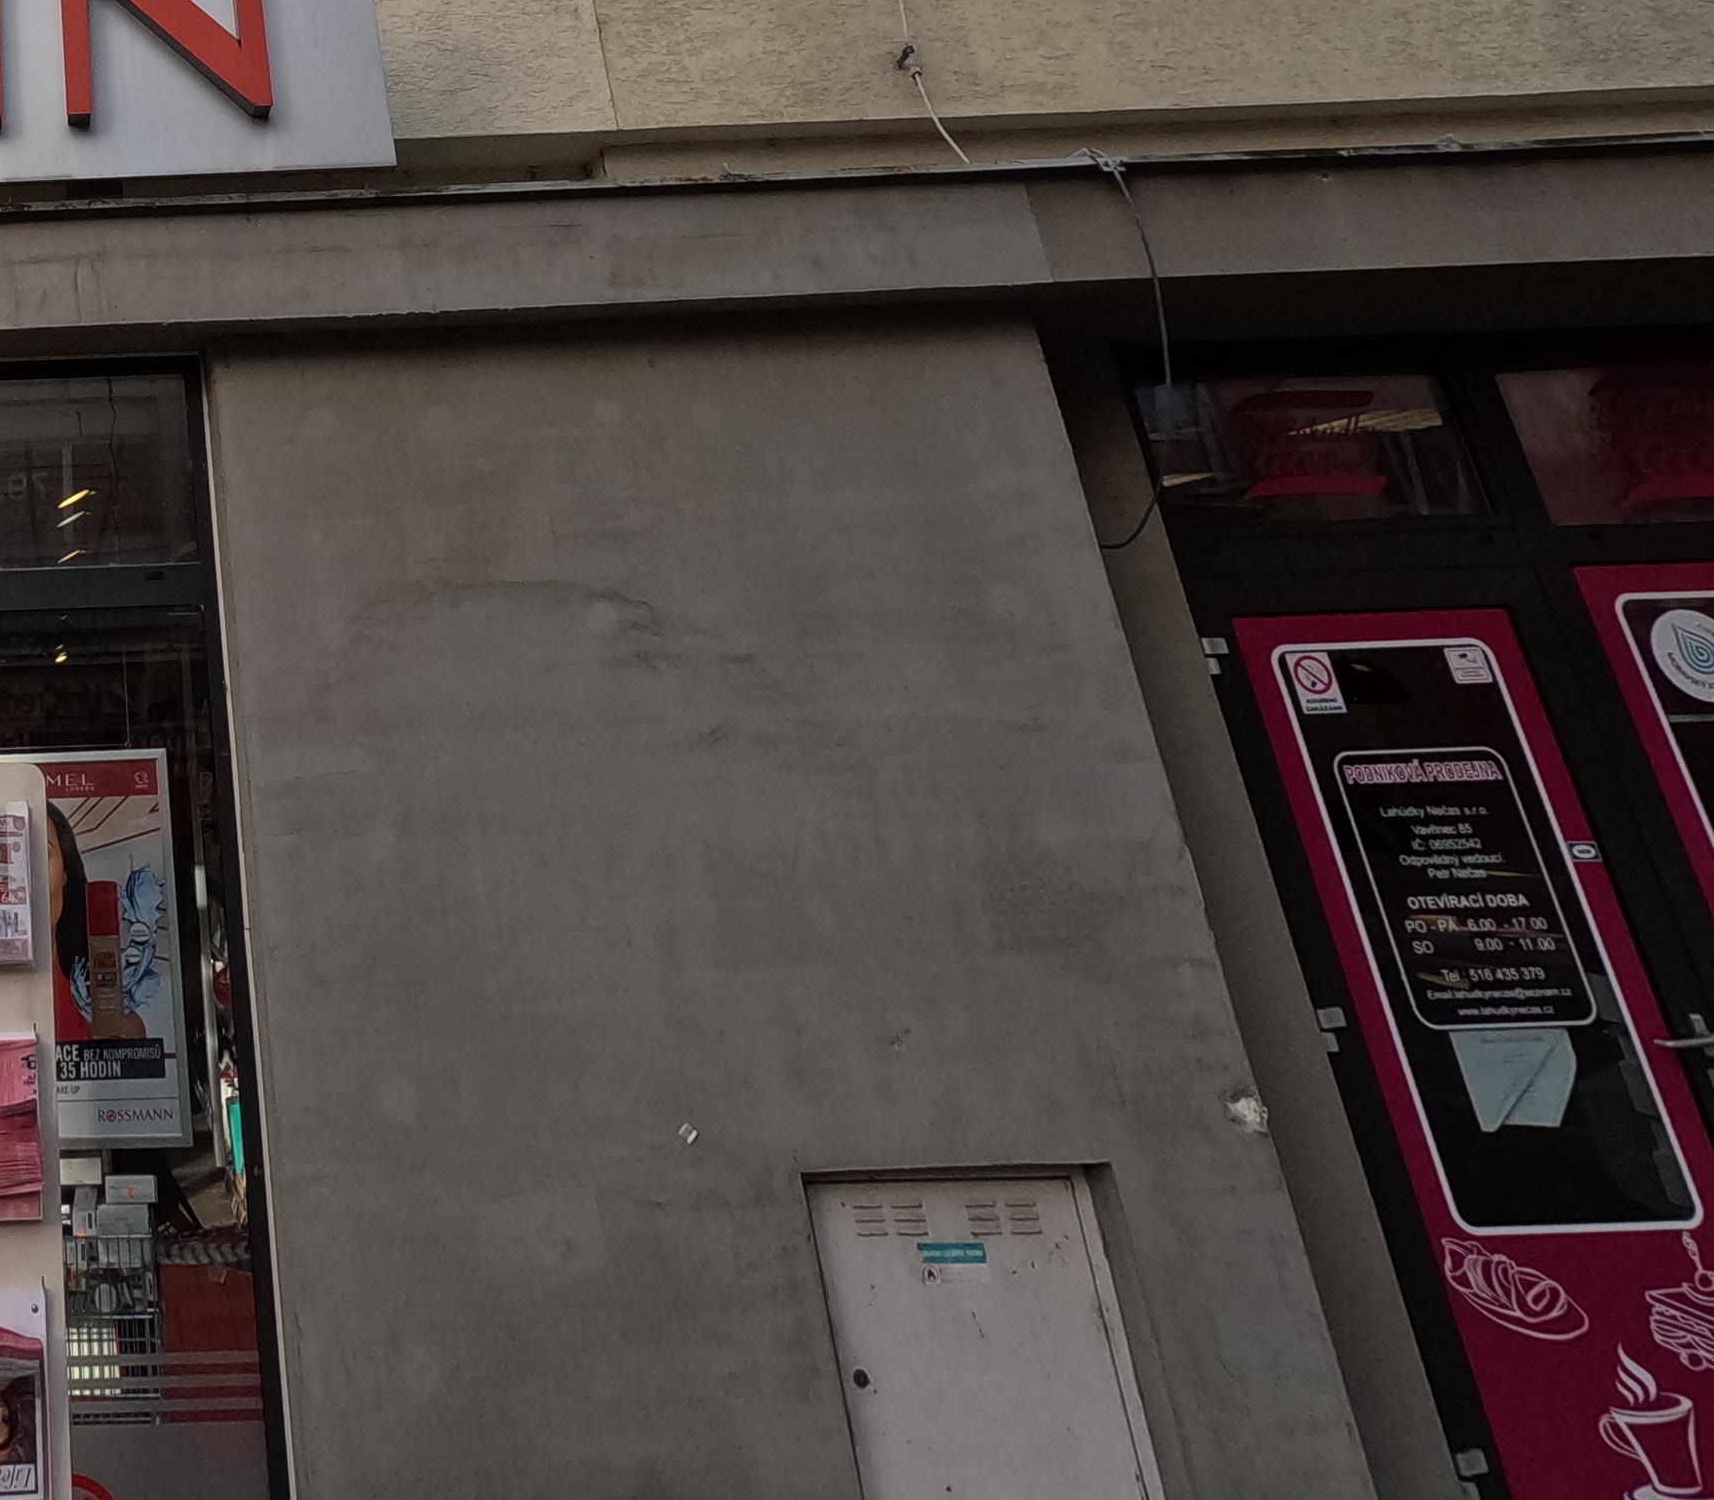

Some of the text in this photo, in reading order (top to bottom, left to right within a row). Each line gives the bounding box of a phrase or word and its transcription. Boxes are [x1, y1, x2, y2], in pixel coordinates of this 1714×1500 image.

[46, 772, 95, 787] MEL
[1342, 758, 1504, 785] PODNIKOVÁ PRODEJNA
[1406, 891, 1531, 911] OTEVÍRACÍ DOBA
[1404, 919, 1429, 934] PO
[1466, 916, 1497, 931] 6.00
[1412, 939, 1436, 955] SO
[1474, 936, 1504, 951] 9.00
[1469, 967, 1494, 982] 516
[1495, 966, 1519, 981] 435
[1521, 965, 1546, 980] 379
[55, 1043, 162, 1061] ACE BEZ KOMPROMISŮ
[59, 1060, 122, 1079] 35 HODIN
[97, 1108, 174, 1122] ROSSMANN
